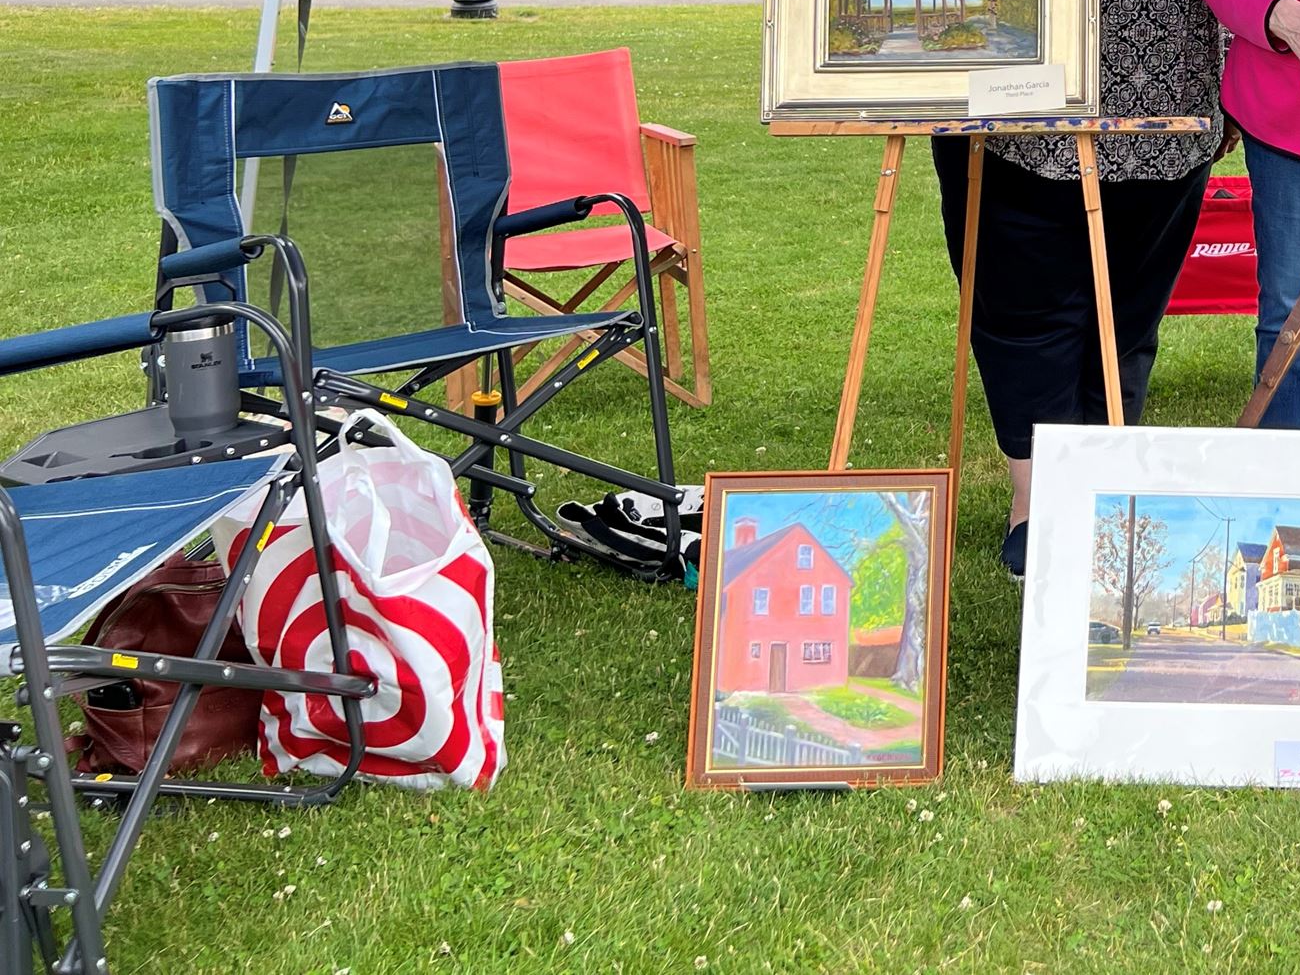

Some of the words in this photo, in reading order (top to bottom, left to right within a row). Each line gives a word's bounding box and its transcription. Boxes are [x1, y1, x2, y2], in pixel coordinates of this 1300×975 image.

[988, 82, 1024, 93] Jonathan
[1025, 81, 1050, 90] Garcia
[1190, 242, 1251, 257] RADIO
